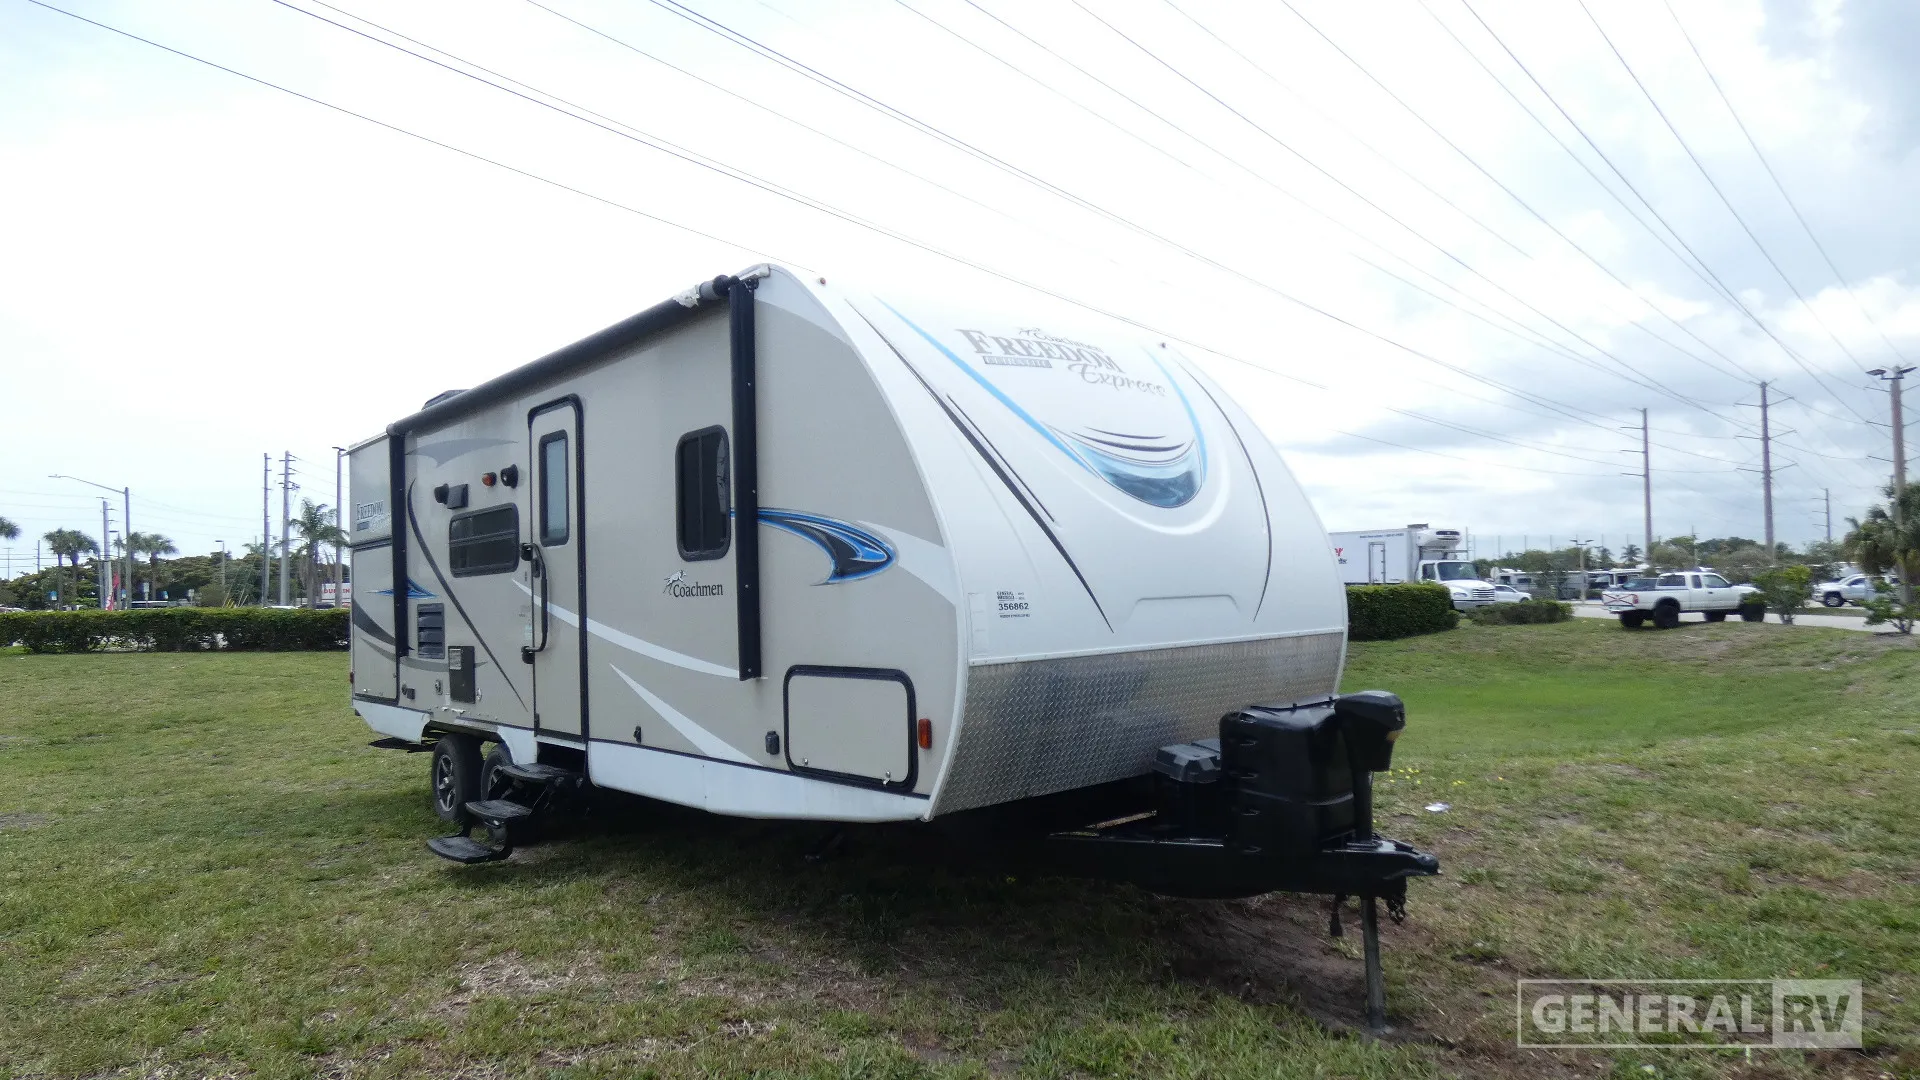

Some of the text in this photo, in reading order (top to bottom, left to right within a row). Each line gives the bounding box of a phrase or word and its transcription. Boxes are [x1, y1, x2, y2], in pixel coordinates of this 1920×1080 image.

[954, 328, 1126, 374] FREEDOM
[1067, 363, 1167, 398] Express
[673, 581, 723, 597] Coachmen
[998, 602, 1030, 611] 356862
